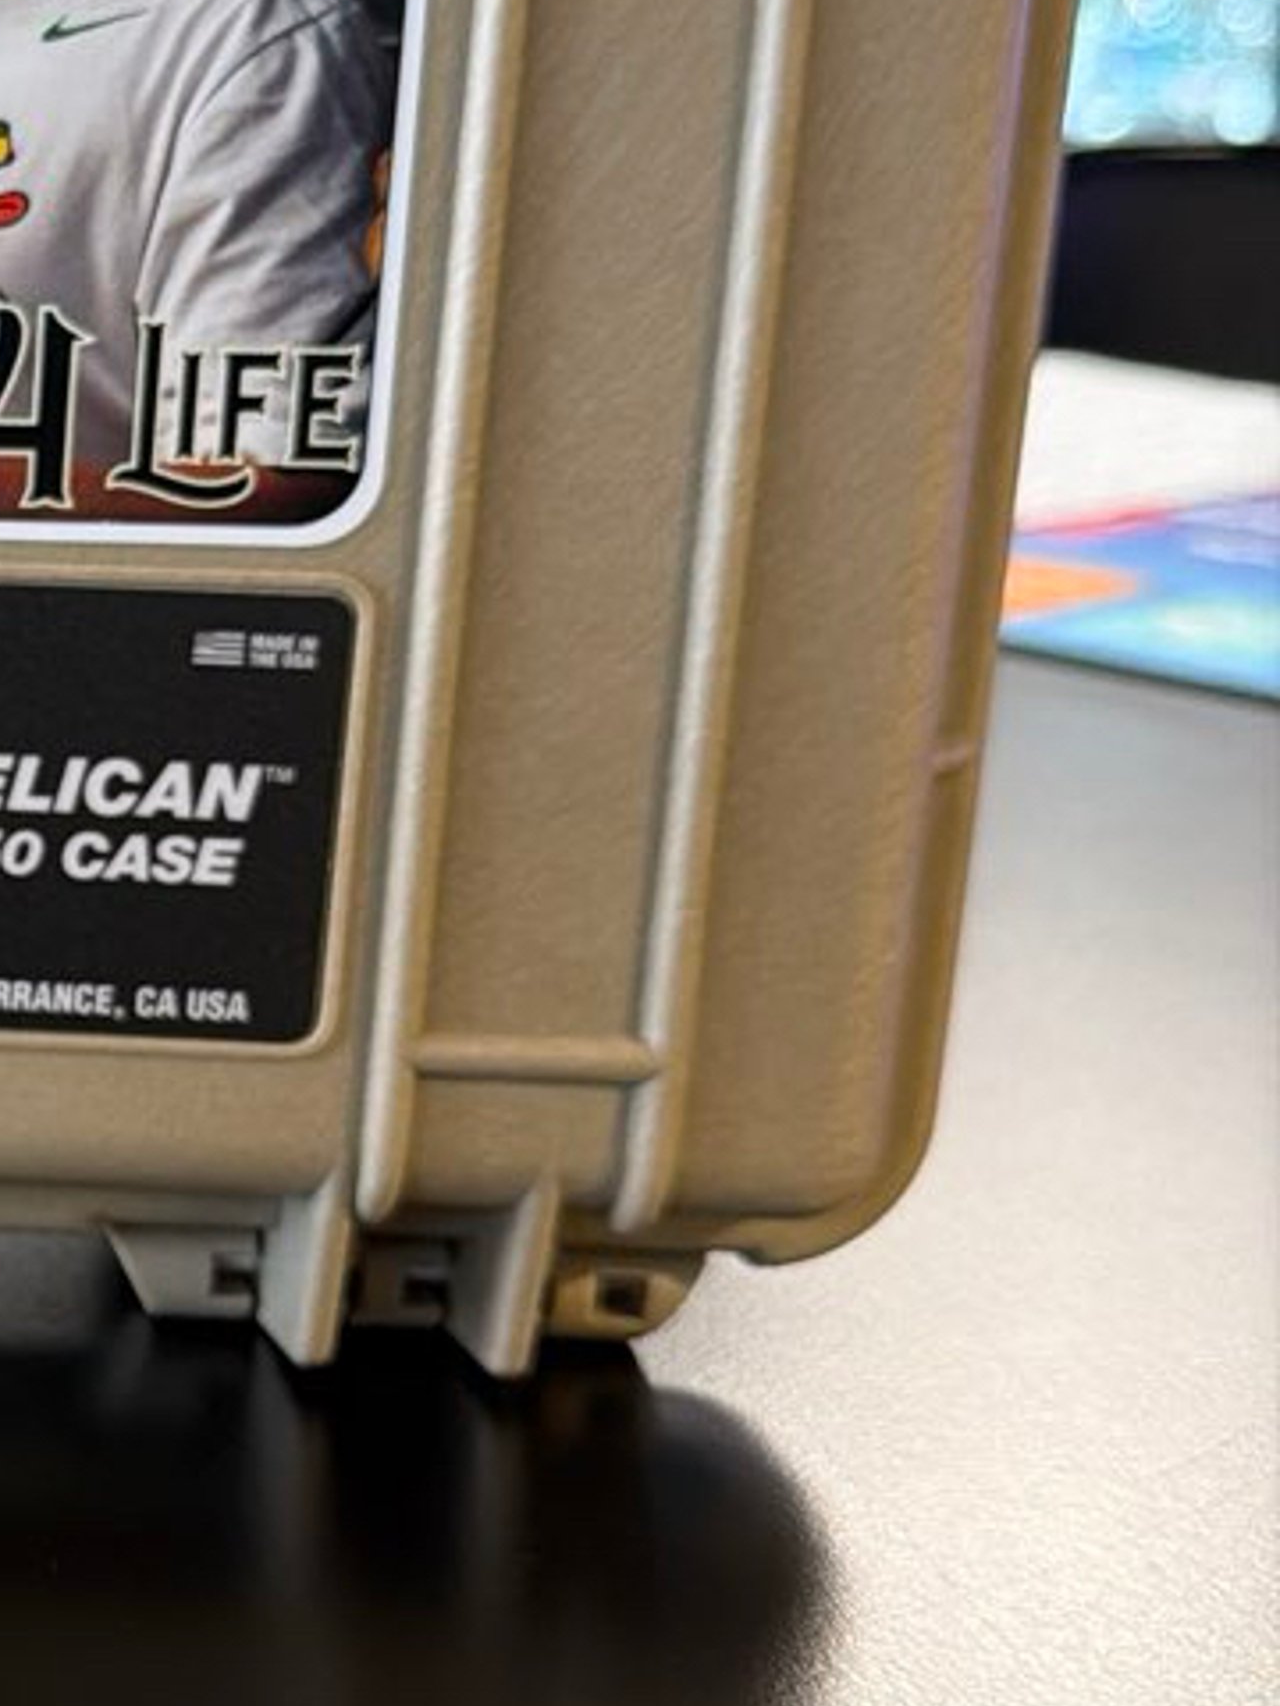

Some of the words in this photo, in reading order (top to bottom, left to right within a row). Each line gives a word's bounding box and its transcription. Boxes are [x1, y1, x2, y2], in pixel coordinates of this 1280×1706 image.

[61, 830, 244, 886] CASE
[134, 986, 178, 1019] CA
[185, 988, 249, 1023] USA
